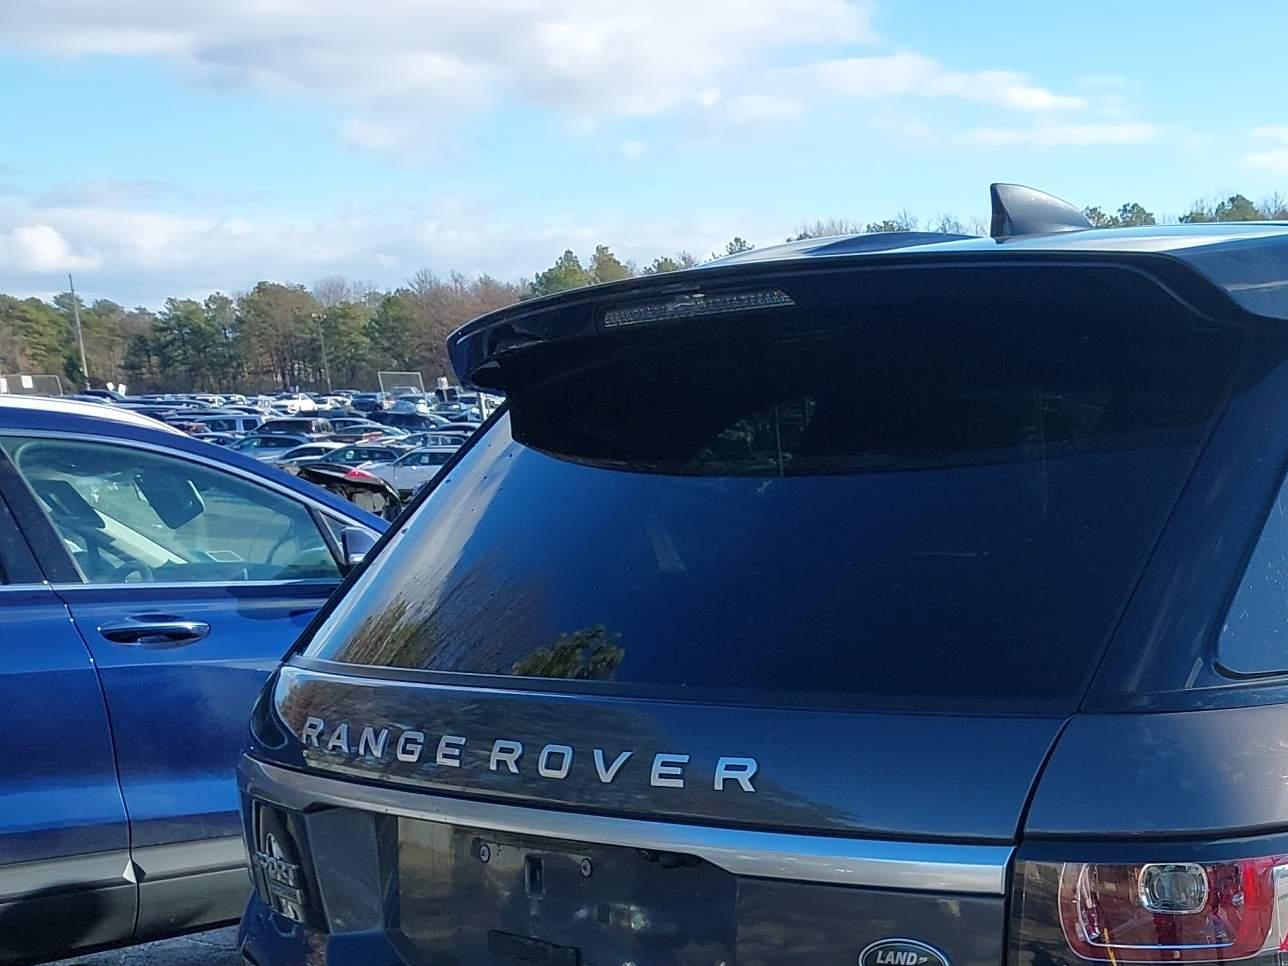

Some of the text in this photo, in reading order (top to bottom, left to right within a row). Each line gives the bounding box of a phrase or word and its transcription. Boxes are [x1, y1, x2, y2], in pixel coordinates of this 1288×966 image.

[302, 716, 759, 793] RANGE ROVER
[876, 950, 918, 966] LAND
